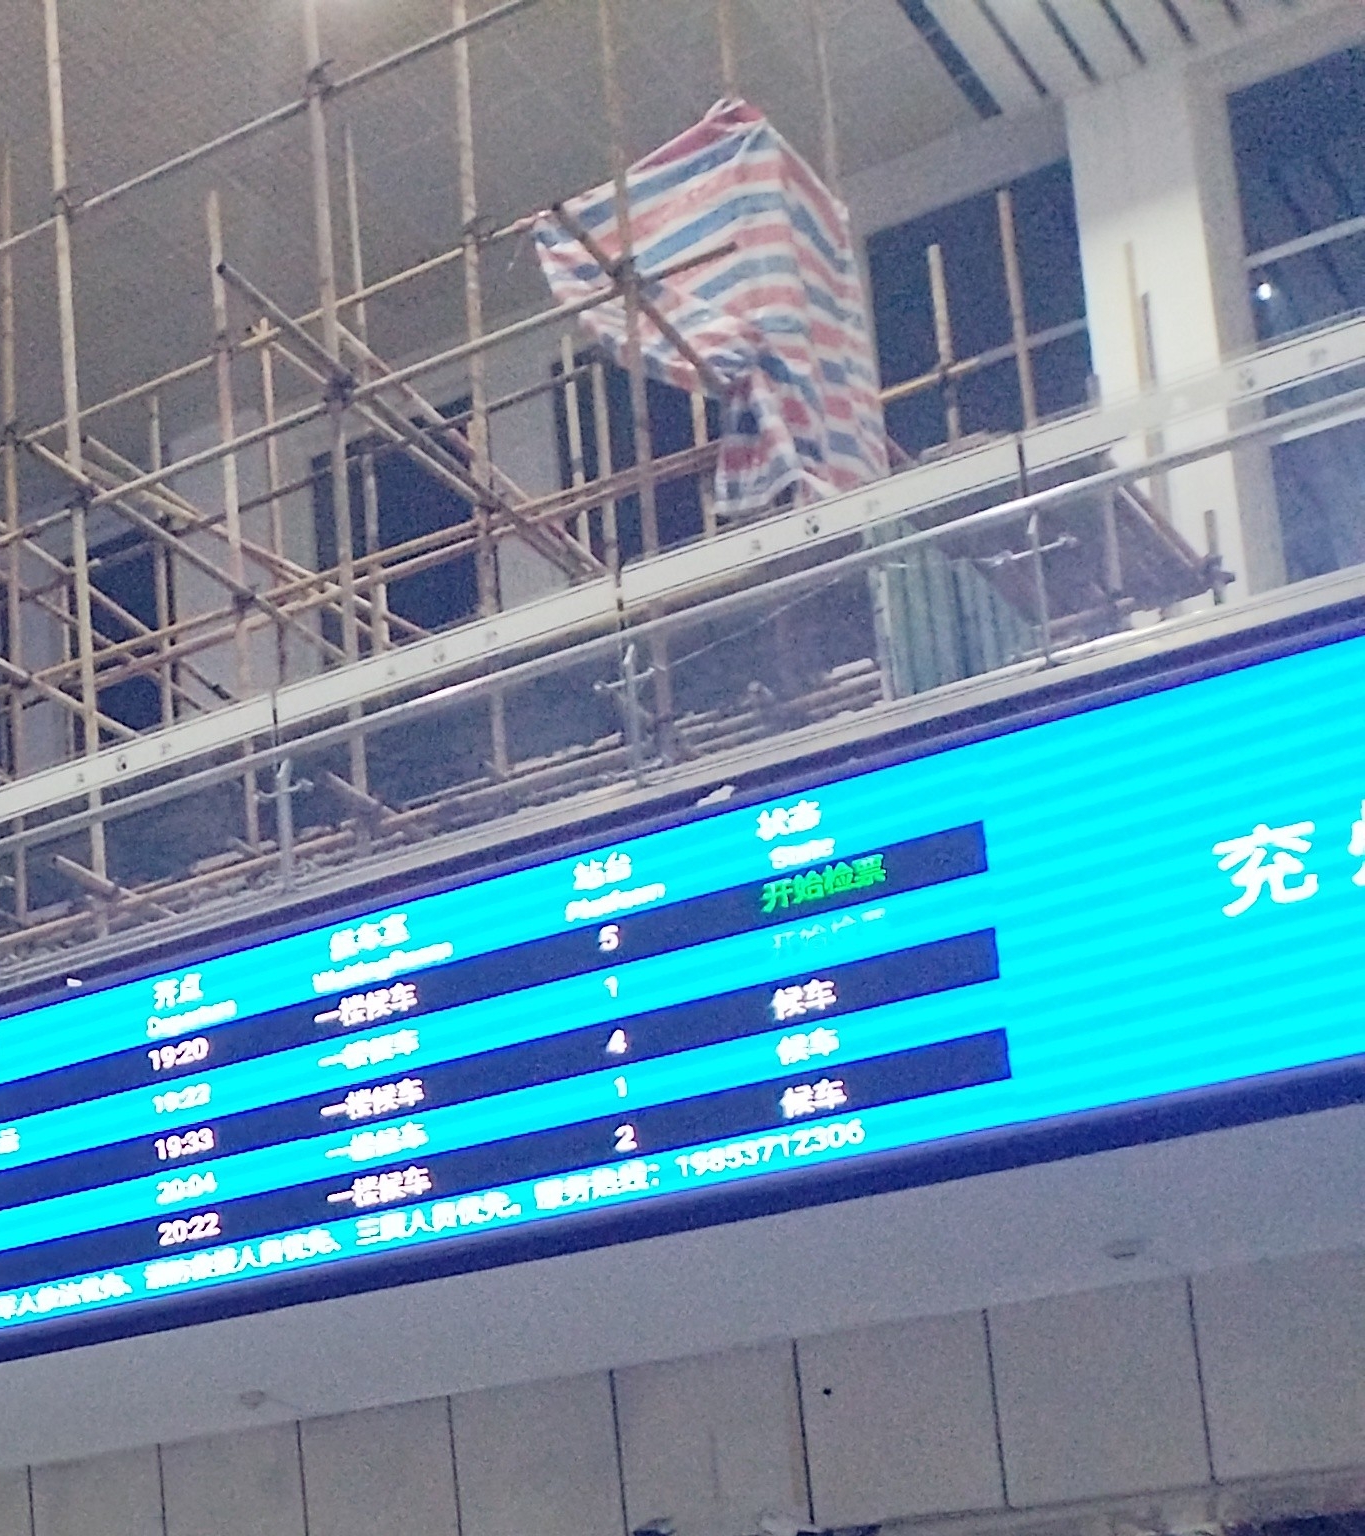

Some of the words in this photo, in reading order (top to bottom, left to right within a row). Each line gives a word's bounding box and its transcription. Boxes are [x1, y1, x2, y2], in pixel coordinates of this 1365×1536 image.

[148, 1038, 210, 1070] 19:20
[599, 925, 619, 951] 5
[761, 853, 886, 913] 开始检票
[605, 976, 618, 997] 1
[155, 1128, 214, 1159] 19:33
[607, 1030, 628, 1055] 4
[771, 979, 836, 1020] 候车
[614, 1076, 627, 1097] 1
[777, 1028, 840, 1065] 候车
[158, 1213, 220, 1246] 20:22
[615, 1125, 638, 1152] 2
[780, 1079, 847, 1118] 候车
